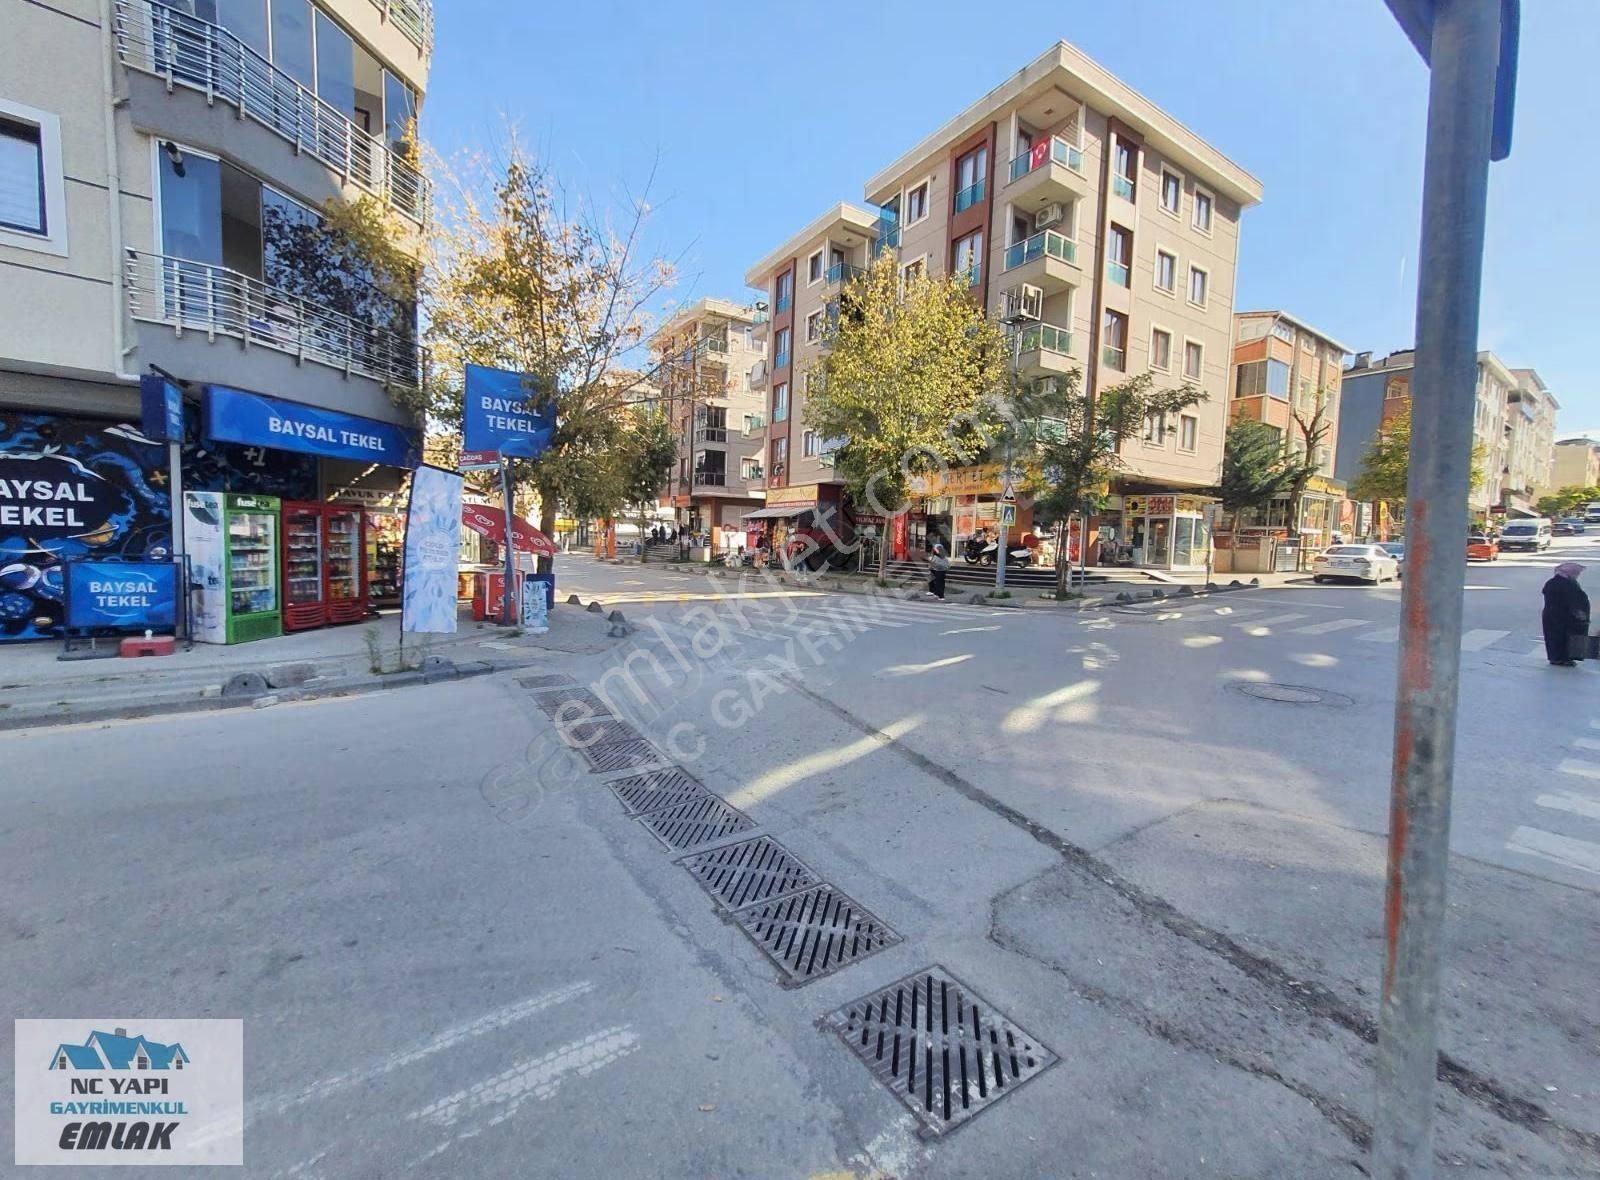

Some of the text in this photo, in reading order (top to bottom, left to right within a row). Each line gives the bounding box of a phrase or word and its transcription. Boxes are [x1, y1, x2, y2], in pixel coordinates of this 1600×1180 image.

[481, 396, 541, 417] BAYSAL
[269, 416, 385, 451] BAYSAL TEKEL
[486, 414, 535, 433] TEKEL
[0, 479, 94, 501] AYSAL
[90, 581, 157, 593] BAYSAL
[96, 596, 152, 607] TEKEL
